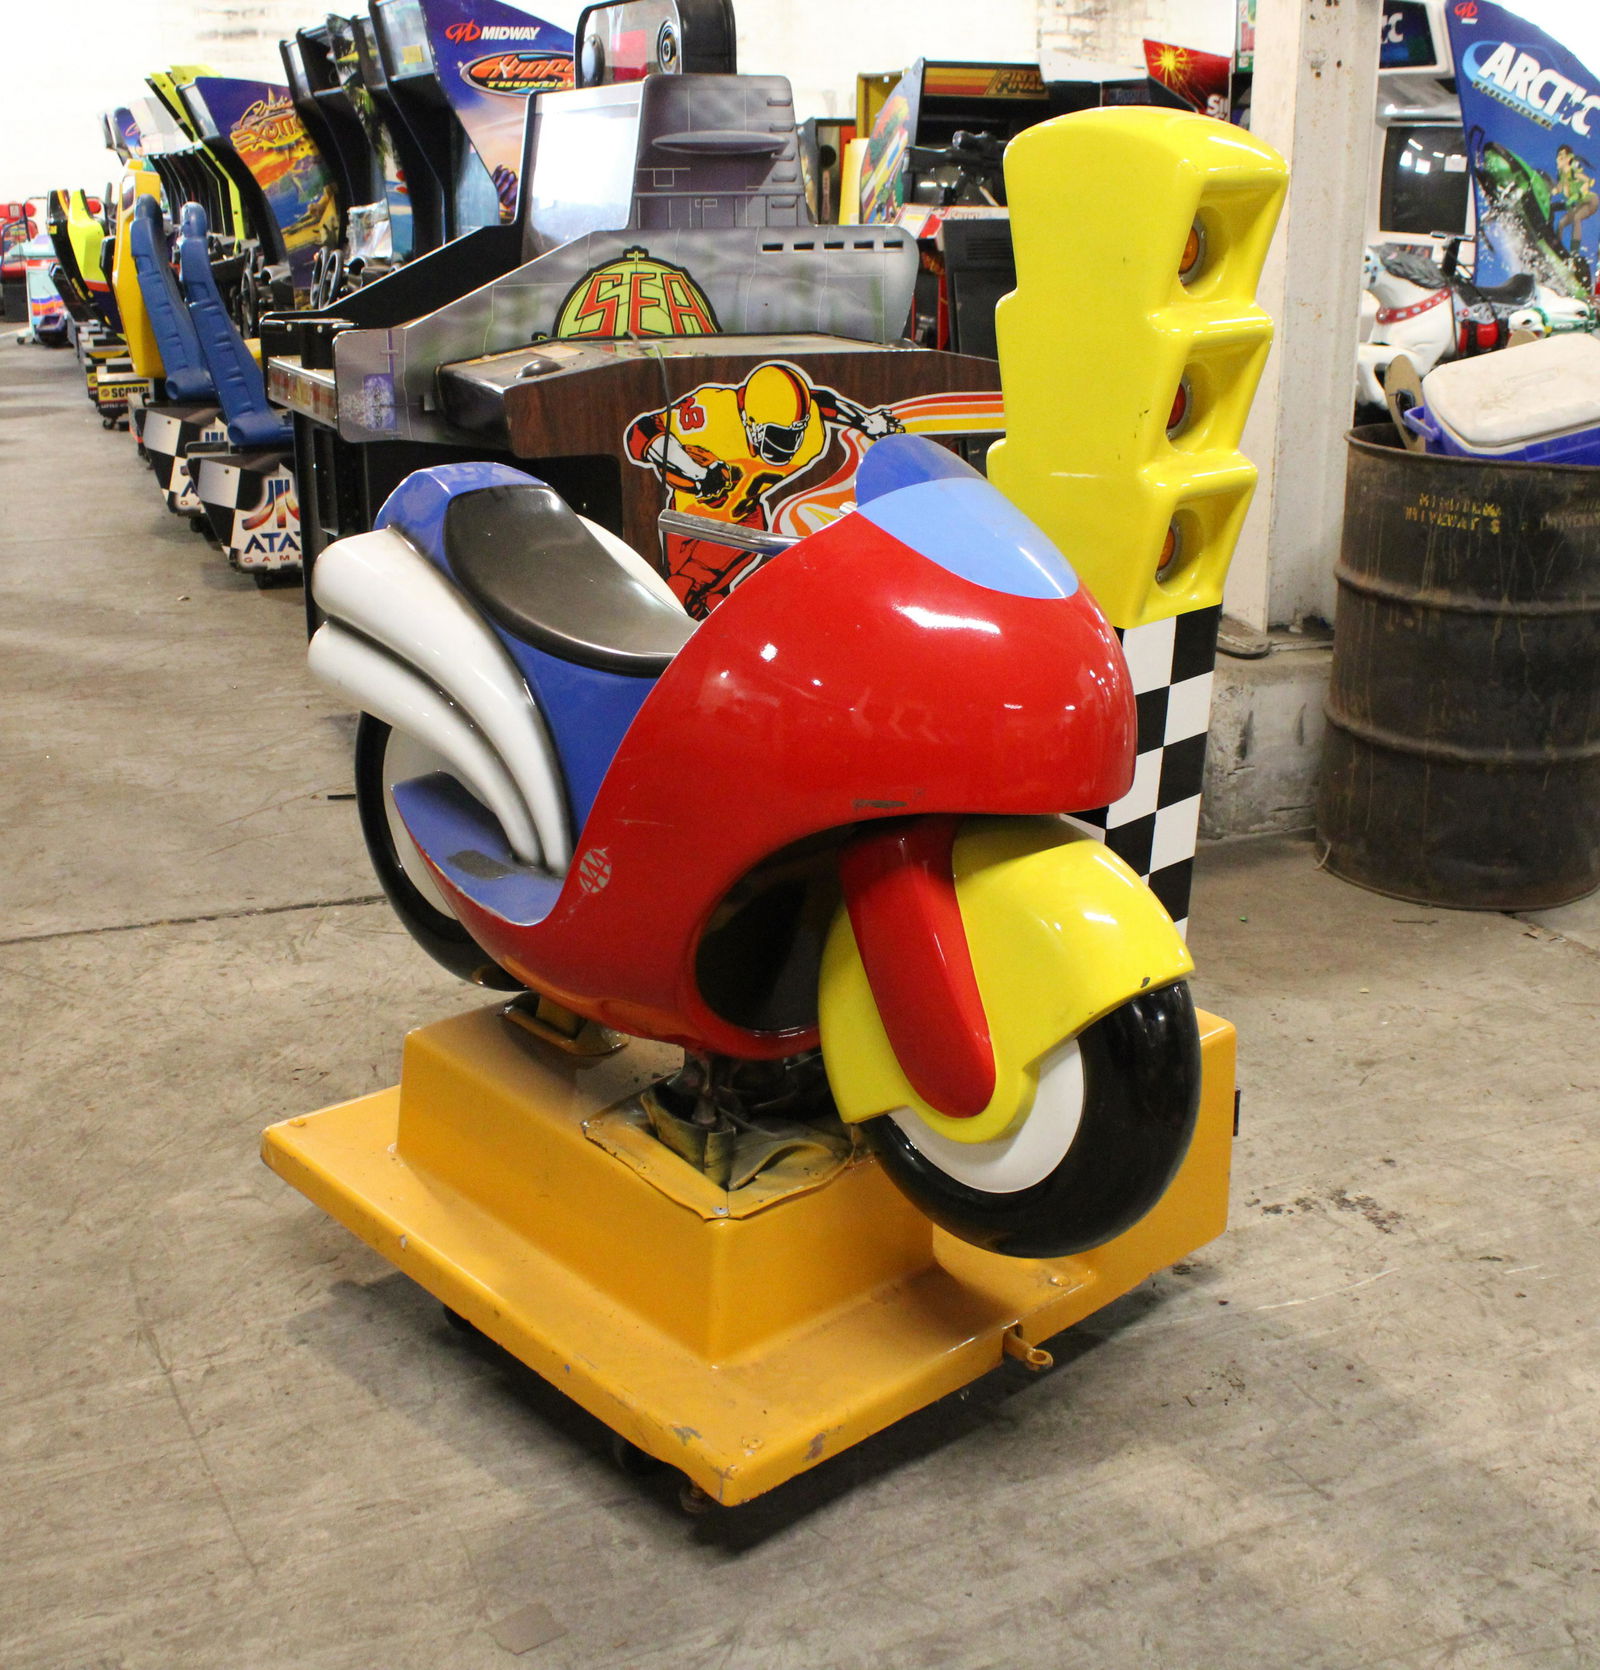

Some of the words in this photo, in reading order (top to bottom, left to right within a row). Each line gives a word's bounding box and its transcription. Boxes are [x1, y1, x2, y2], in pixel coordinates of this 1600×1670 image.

[480, 26, 541, 40] MIDWAY
[1477, 41, 1600, 136] ARCTIC
[567, 272, 714, 337] SEA
